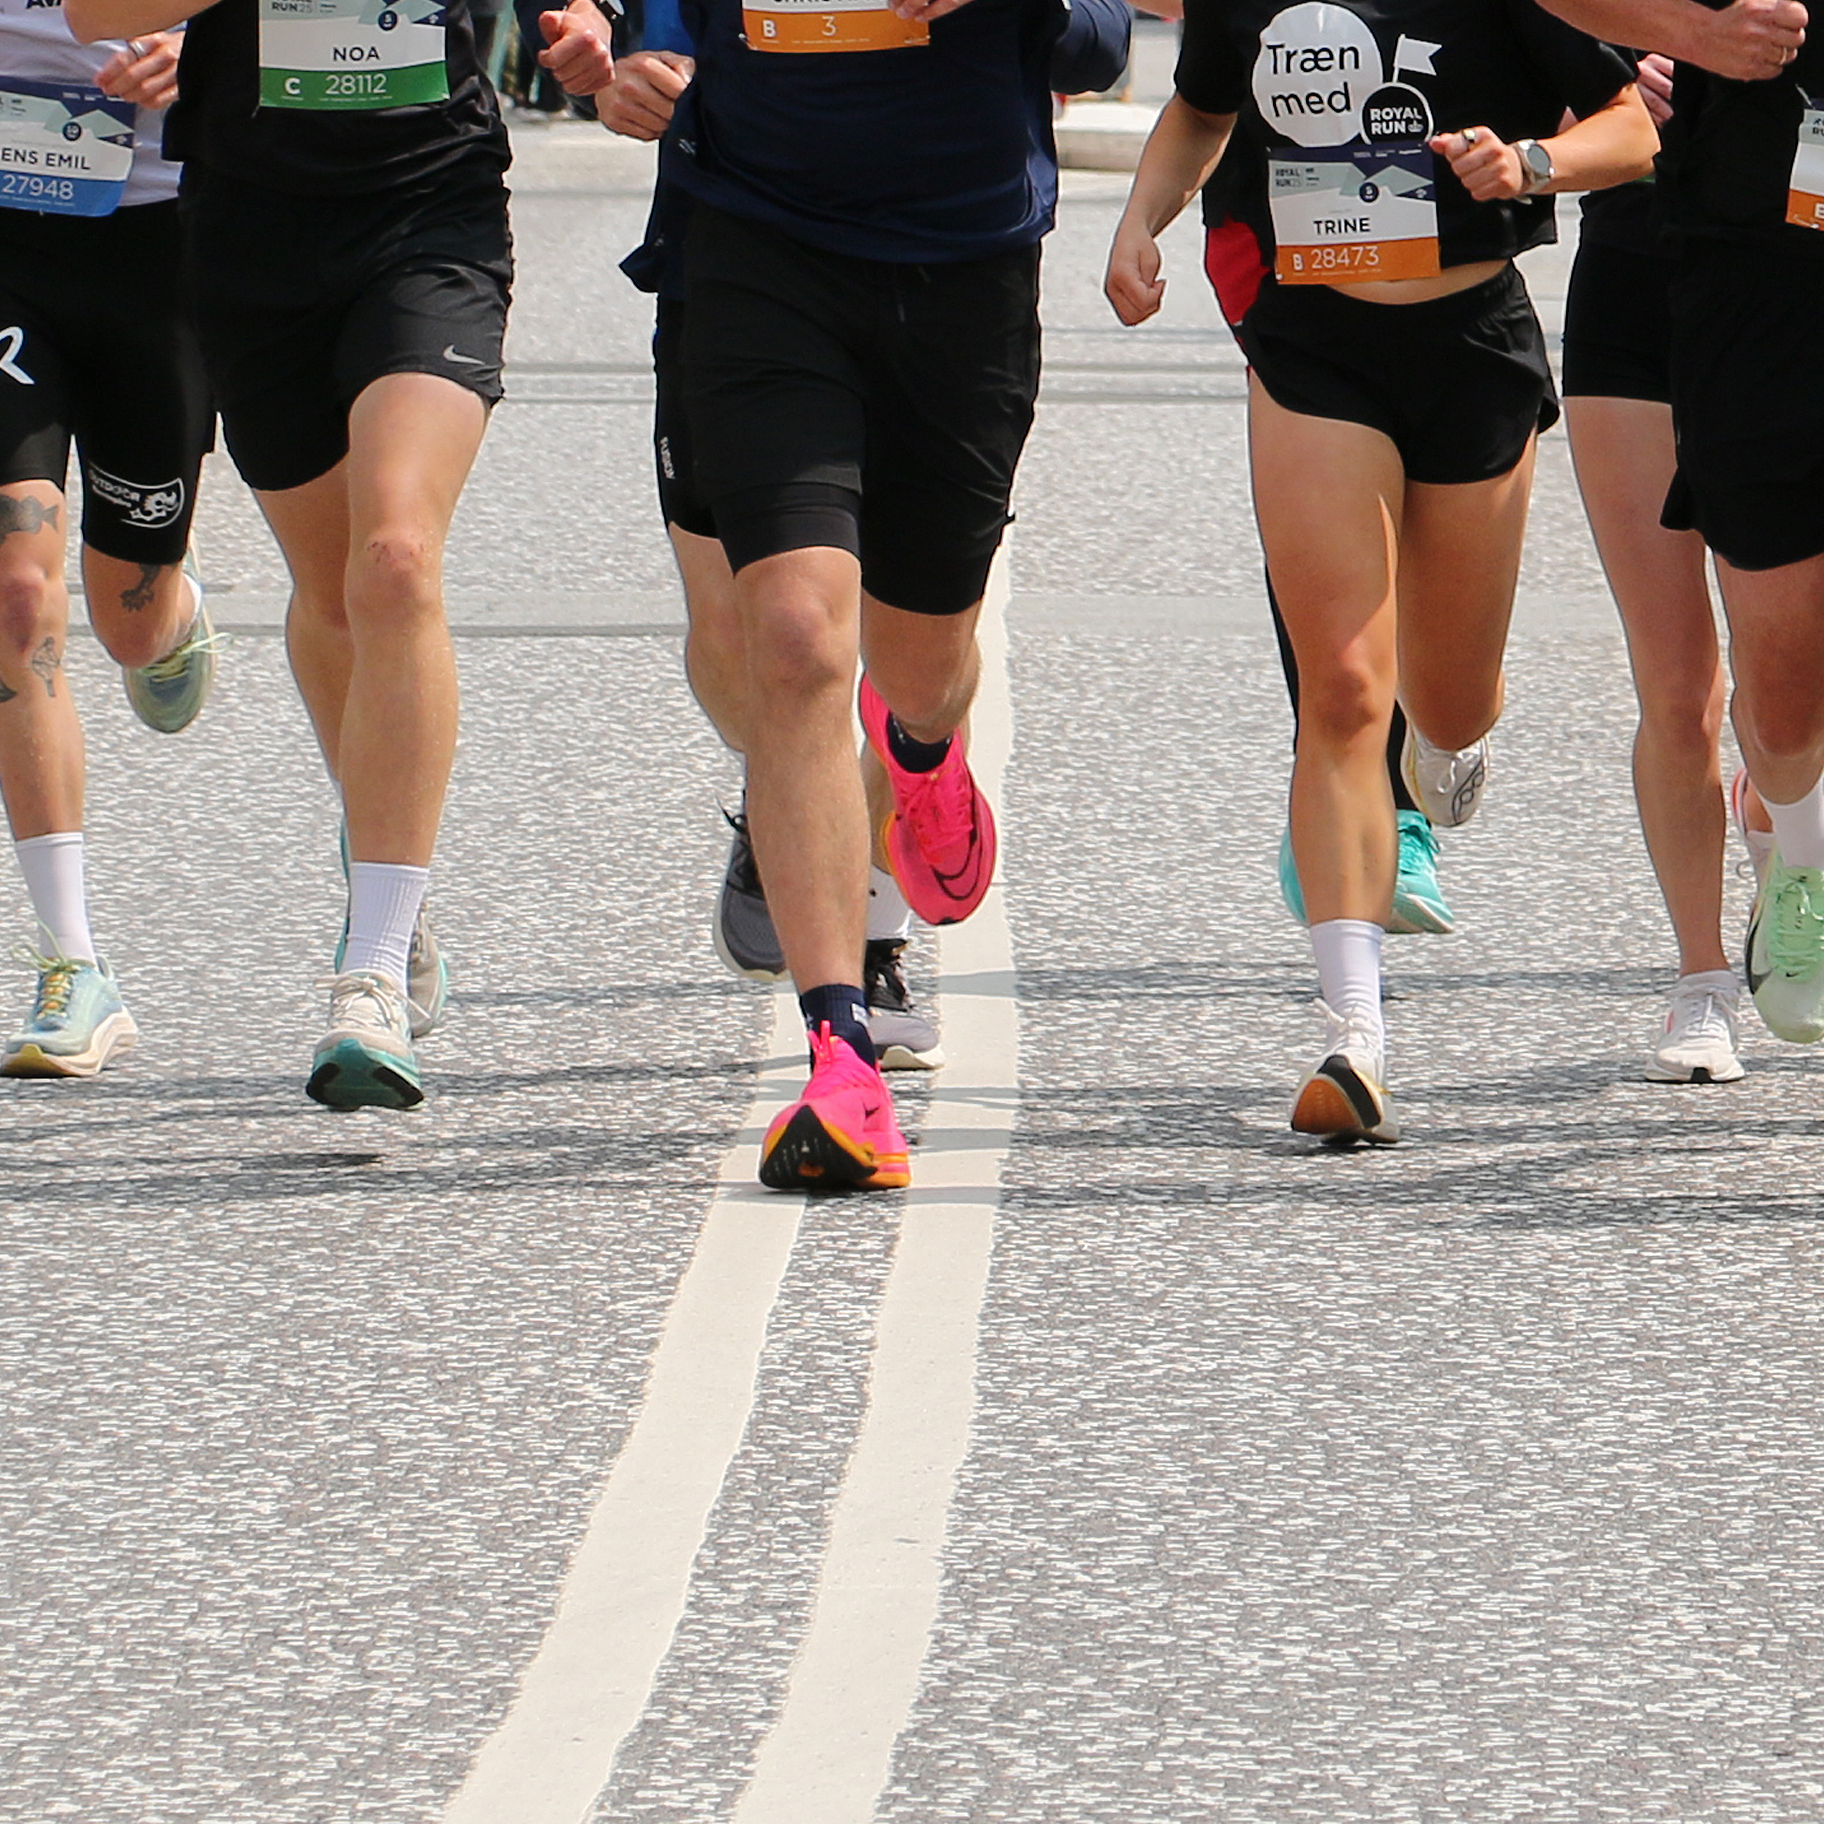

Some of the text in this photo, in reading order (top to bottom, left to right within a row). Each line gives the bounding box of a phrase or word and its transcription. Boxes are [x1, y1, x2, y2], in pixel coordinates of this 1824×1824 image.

[762, 15, 837, 38] B 3
[333, 46, 381, 62] NOA
[1266, 43, 1359, 75] Træn
[284, 74, 388, 95] C 28112
[1271, 81, 1351, 118] med
[1369, 106, 1423, 122] ROYAL
[1371, 120, 1407, 136] RUN
[45, 152, 92, 171] EMIL
[2, 174, 74, 201] 27948
[1313, 217, 1371, 235] TRINE
[1292, 245, 1380, 271] B 28473
